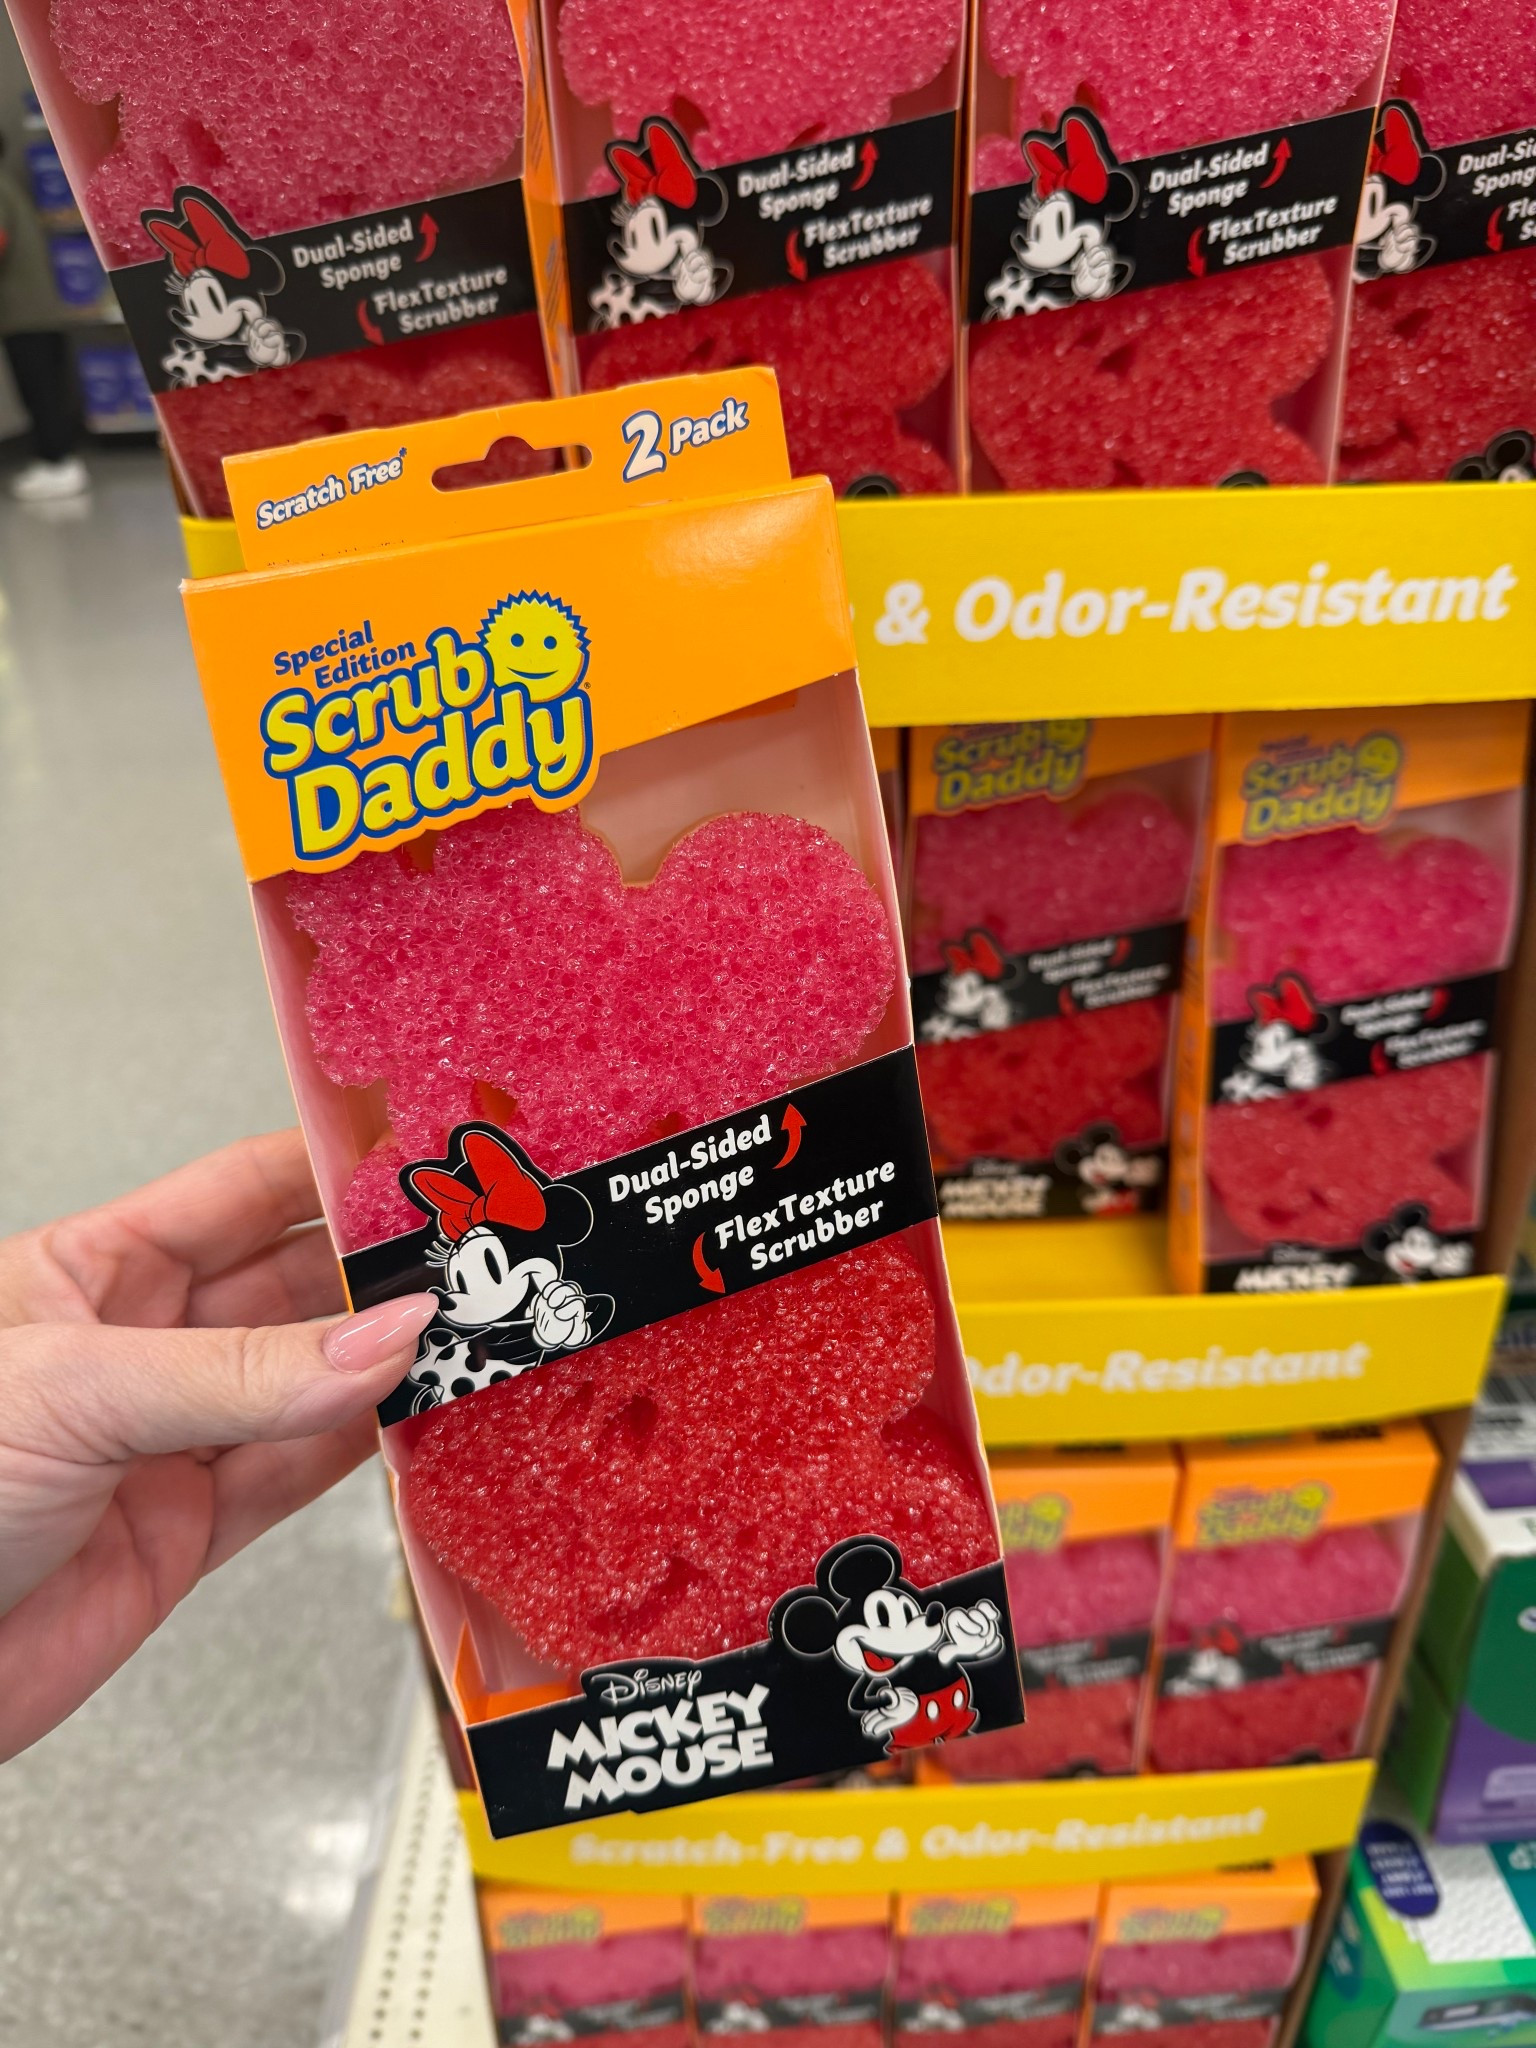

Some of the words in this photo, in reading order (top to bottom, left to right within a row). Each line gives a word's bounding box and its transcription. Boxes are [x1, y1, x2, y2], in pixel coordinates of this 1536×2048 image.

[738, 141, 855, 198] Dual-Sided
[1149, 141, 1270, 194] Dual-Sided
[758, 179, 840, 222] Sponge
[803, 193, 933, 248] FlexTexture
[1167, 179, 1250, 218] Sponge
[1208, 196, 1339, 245] FlexTexture
[292, 216, 414, 269] Dual-Sided
[823, 223, 921, 269] Scrubber
[1223, 224, 1323, 266] Scrubber
[320, 253, 403, 291] Sponge
[372, 265, 508, 316] FlexTexture
[398, 293, 500, 334] Scrubber
[622, 410, 667, 483] 2
[669, 397, 748, 455] Pack
[257, 475, 345, 530] Scratch
[874, 579, 930, 646] &
[954, 561, 1520, 644] Odor-Resistant
[274, 620, 375, 677] Special
[313, 639, 417, 690] Edition
[263, 630, 490, 775] Scrub
[290, 686, 587, 857] Daddy
[939, 748, 1082, 809] Daddy
[1245, 742, 1354, 797] Scrub
[1249, 777, 1393, 834] Daddy
[608, 1114, 773, 1202] Dual-Sided
[645, 1165, 754, 1224] Sponge
[714, 1161, 896, 1250] FlexTexture
[750, 1200, 884, 1270] Scrubber
[546, 1683, 770, 1770] MICKEY
[564, 1726, 774, 1810] MOUSE
[570, 1830, 863, 1867] Scratch-Free
[872, 1827, 909, 1863] &
[921, 1807, 1268, 1859] Odor-Resistant
